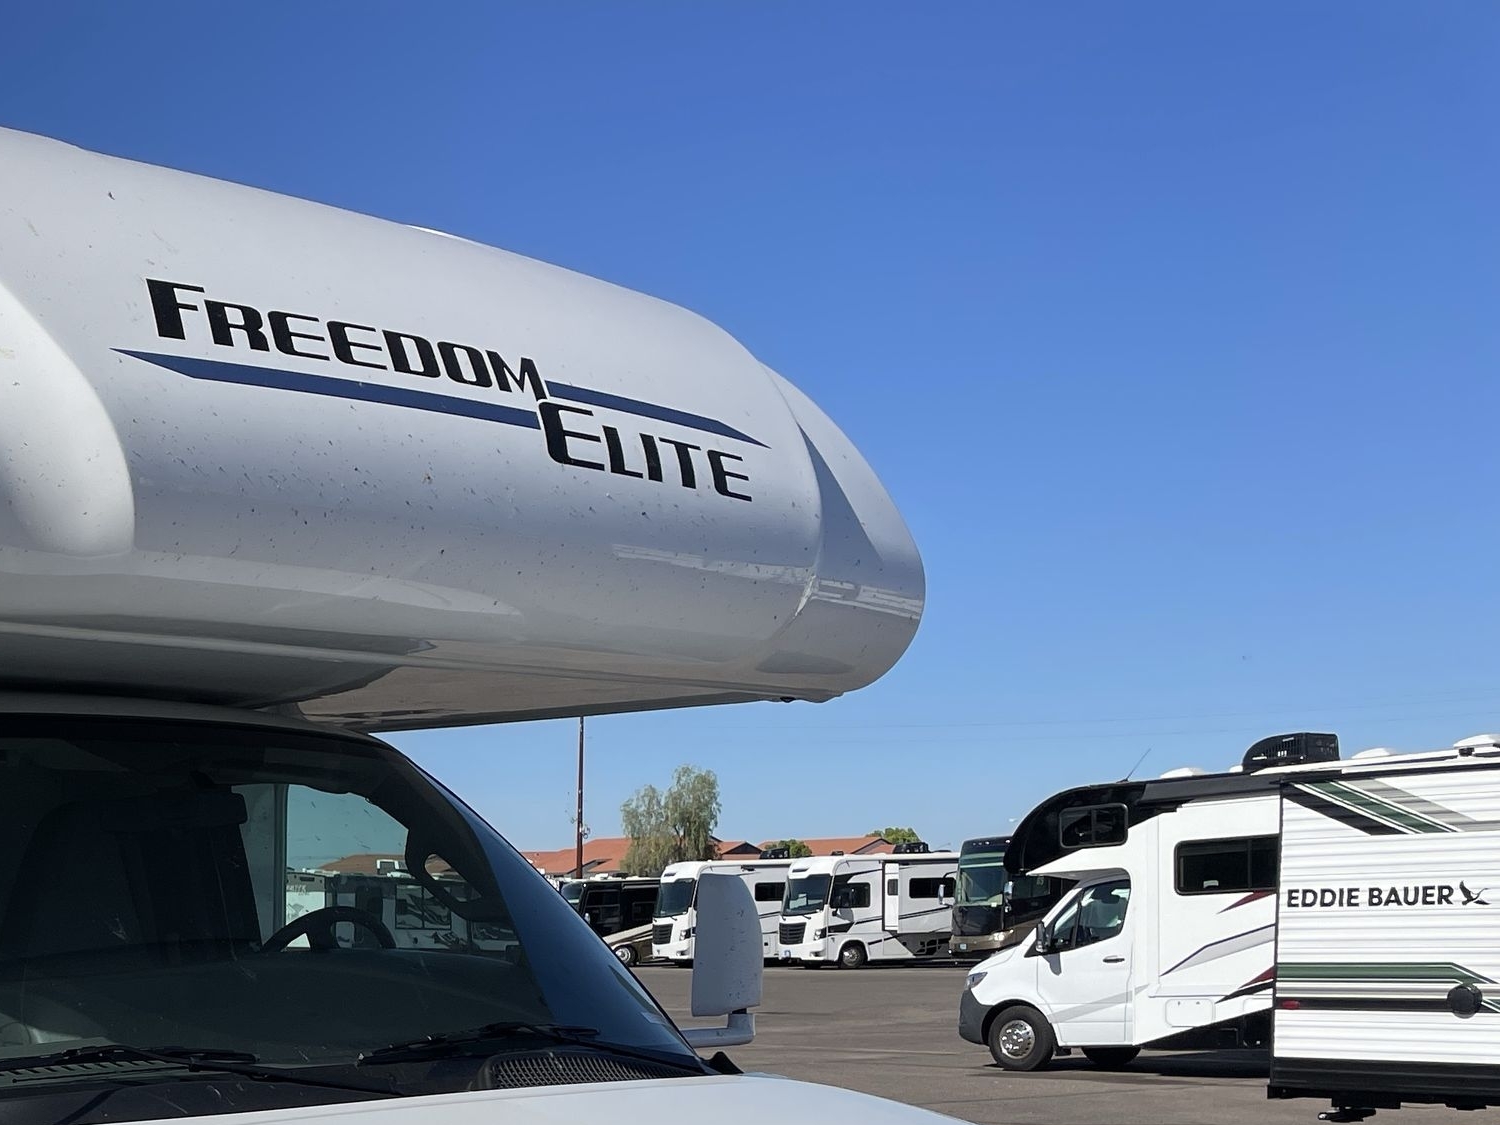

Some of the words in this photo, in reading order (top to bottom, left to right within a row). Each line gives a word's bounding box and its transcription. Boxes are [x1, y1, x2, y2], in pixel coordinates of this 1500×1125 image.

[145, 277, 548, 401] FREEDOM
[539, 400, 753, 503] ELITE
[1286, 887, 1361, 908] EDDIE
[1367, 884, 1455, 907] BAUER
